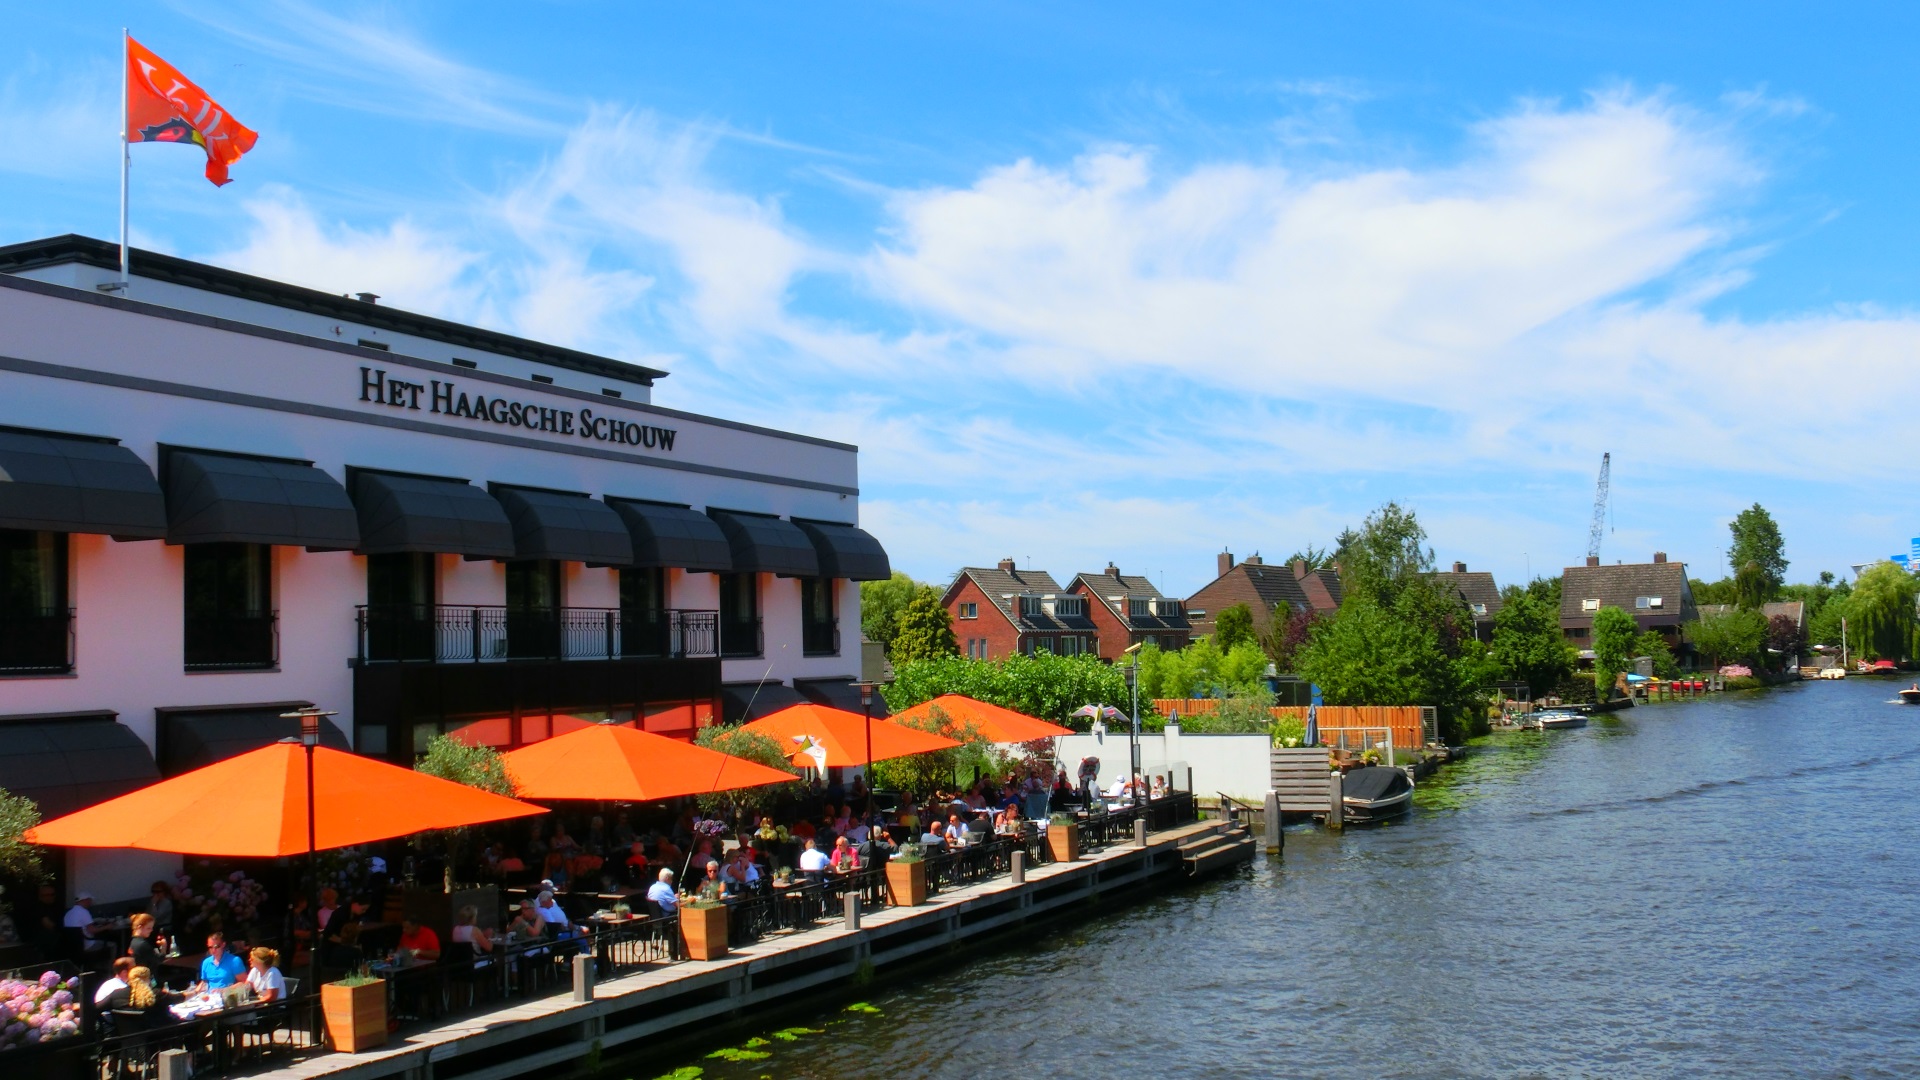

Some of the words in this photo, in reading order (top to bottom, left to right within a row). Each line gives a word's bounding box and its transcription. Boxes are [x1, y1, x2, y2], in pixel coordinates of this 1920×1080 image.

[359, 366, 424, 410] HET
[430, 380, 574, 435] HAAGSCHE
[579, 408, 677, 451] SCHOUW
